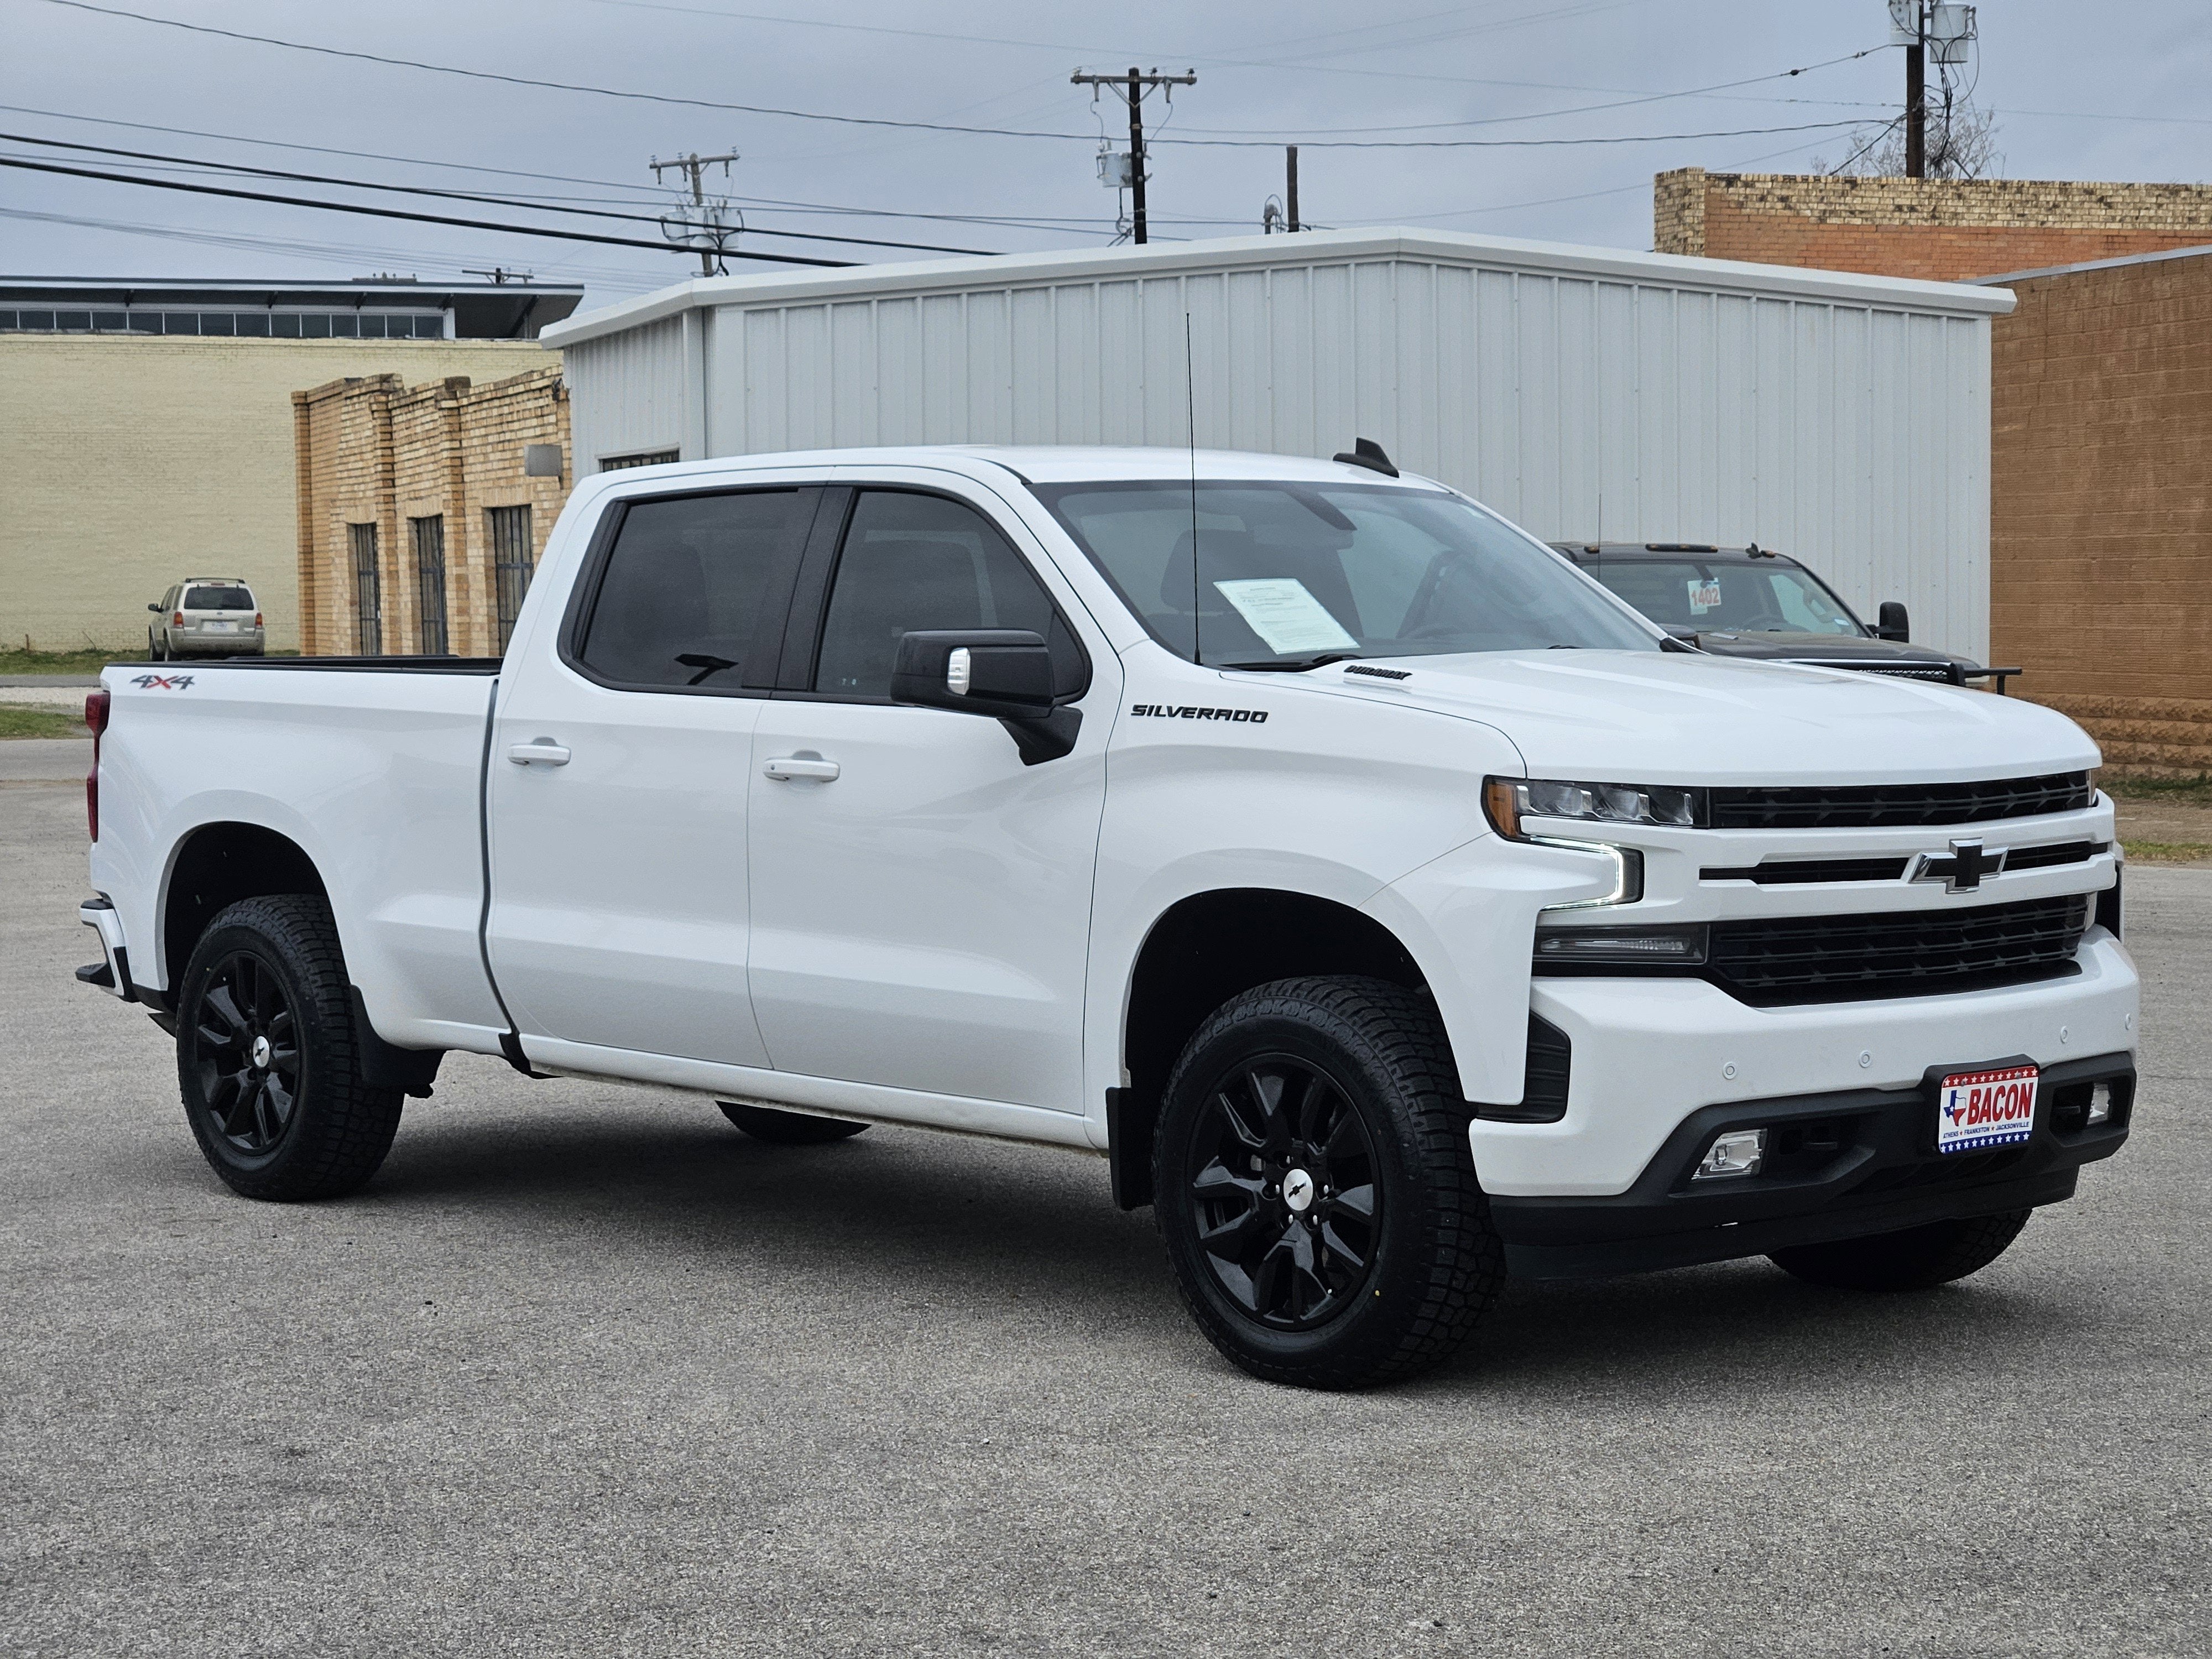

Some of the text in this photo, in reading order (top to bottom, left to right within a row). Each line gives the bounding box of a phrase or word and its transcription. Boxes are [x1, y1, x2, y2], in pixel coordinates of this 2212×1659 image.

[1692, 587, 1719, 606] 1402
[1131, 705, 1269, 723] SILVERADO
[1967, 1082, 2034, 1125] BACON
[1964, 1126, 1990, 1135] FRANKSTON
[1996, 1121, 2029, 1130] JACKSONVILLE
